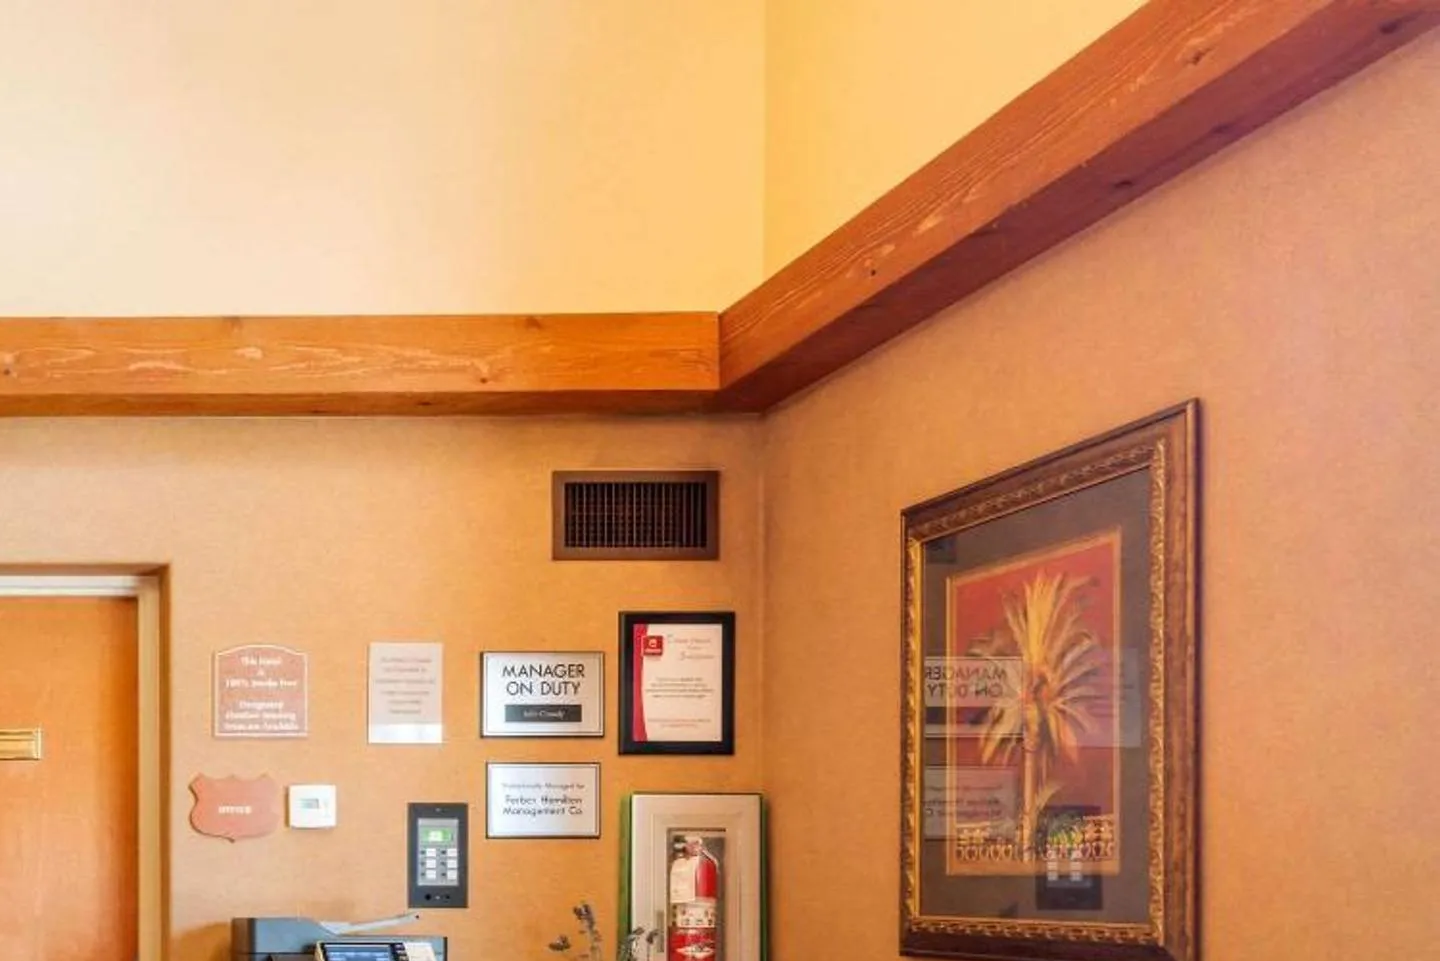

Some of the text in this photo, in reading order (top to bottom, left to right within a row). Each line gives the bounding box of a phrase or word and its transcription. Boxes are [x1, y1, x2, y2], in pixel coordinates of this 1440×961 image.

[502, 663, 585, 678] MANAGER
[506, 681, 581, 696] ON DUTY
[502, 806, 565, 817] Management
